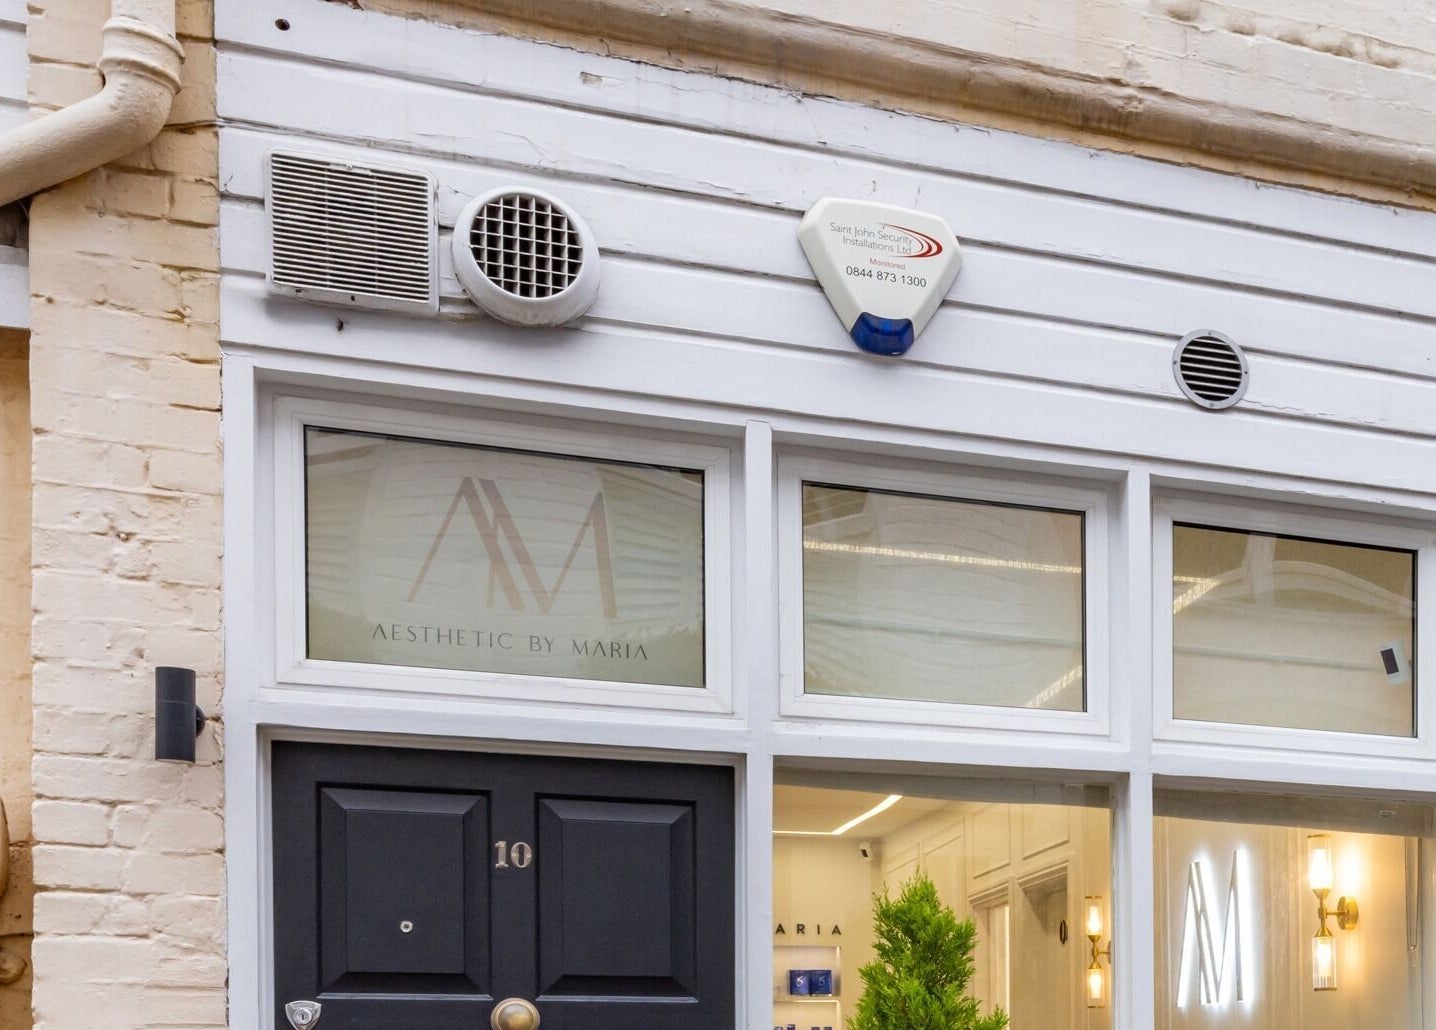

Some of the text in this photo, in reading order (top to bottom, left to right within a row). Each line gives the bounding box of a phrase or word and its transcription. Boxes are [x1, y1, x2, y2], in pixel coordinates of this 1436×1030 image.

[830, 222, 914, 246] Saint John Security
[843, 236, 912, 255] Installations Ltd
[869, 257, 906, 271] Monitored
[846, 265, 927, 288] 0844 873 1300
[371, 623, 649, 661] AESTHETIC BY MARIA
[494, 840, 532, 868] 10
[775, 923, 842, 936] ARIA
